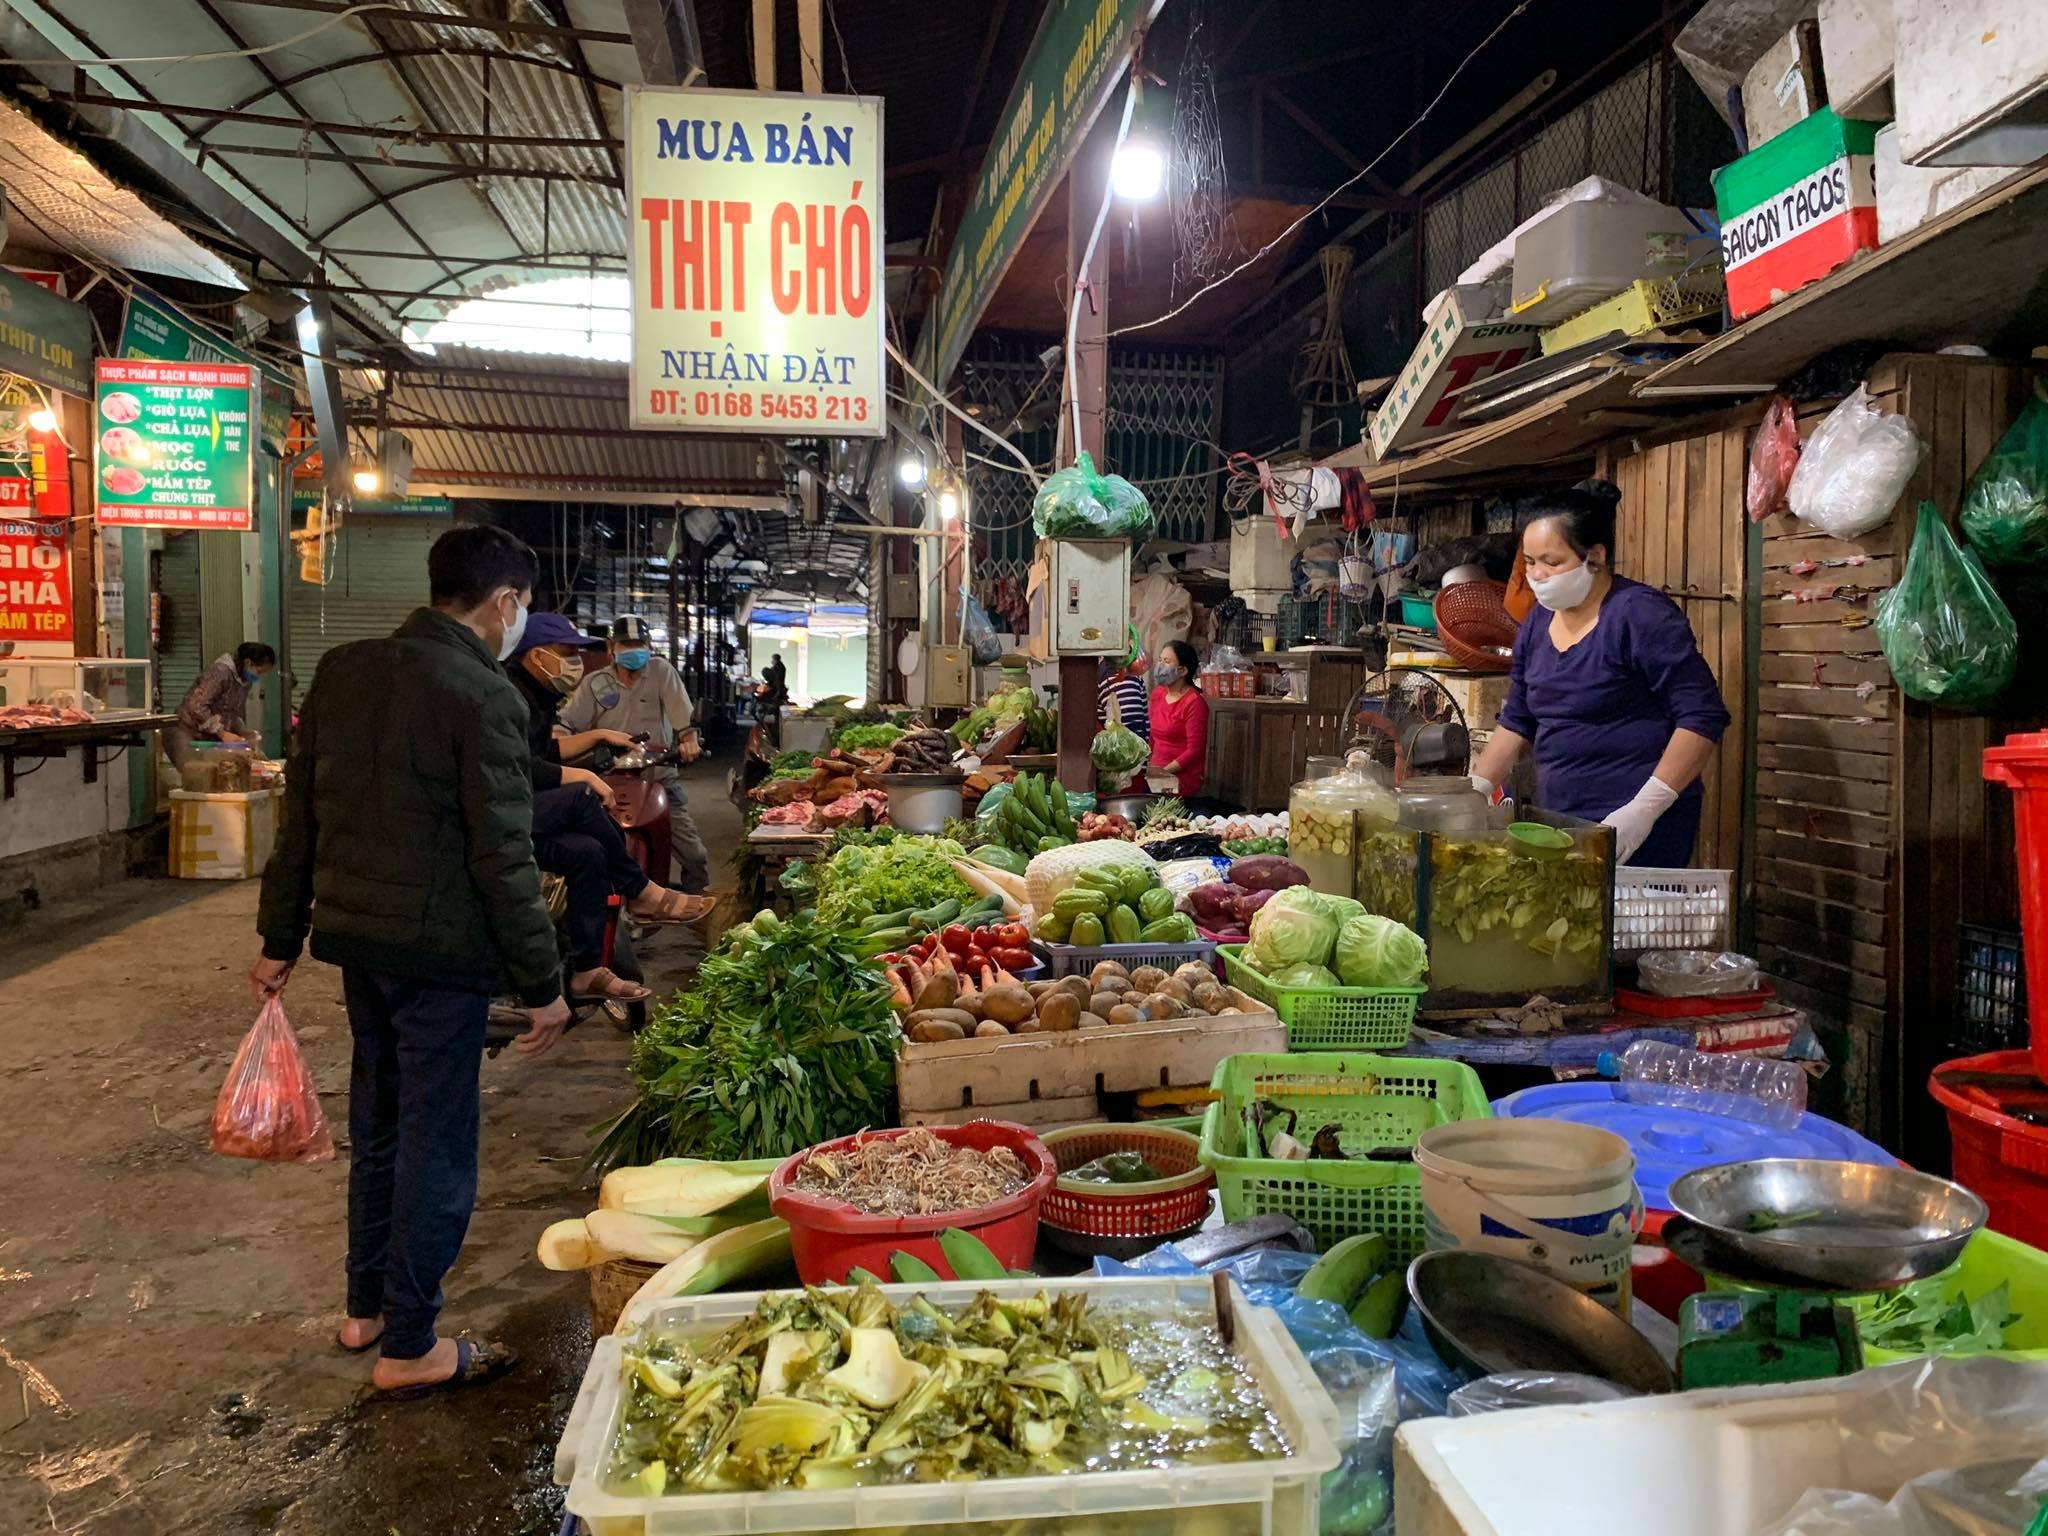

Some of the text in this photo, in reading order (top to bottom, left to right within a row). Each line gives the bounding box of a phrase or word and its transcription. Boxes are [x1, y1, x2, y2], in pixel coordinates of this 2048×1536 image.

[656, 112, 853, 167] MUA BÁN
[1721, 204, 1781, 268] SAIGON
[1782, 167, 1845, 231] TACOS
[641, 198, 751, 338] THỊT
[770, 181, 871, 318] CHÓ
[101, 367, 126, 381] THỰC
[160, 369, 185, 383] SẠCH
[188, 371, 217, 385] MẠNH
[661, 343, 855, 392] NHẬN ĐẶT
[650, 389, 867, 421] ĐT: 0168 5453 213
[0, 540, 61, 570] GIÒ
[33, 610, 66, 630] TÉP
